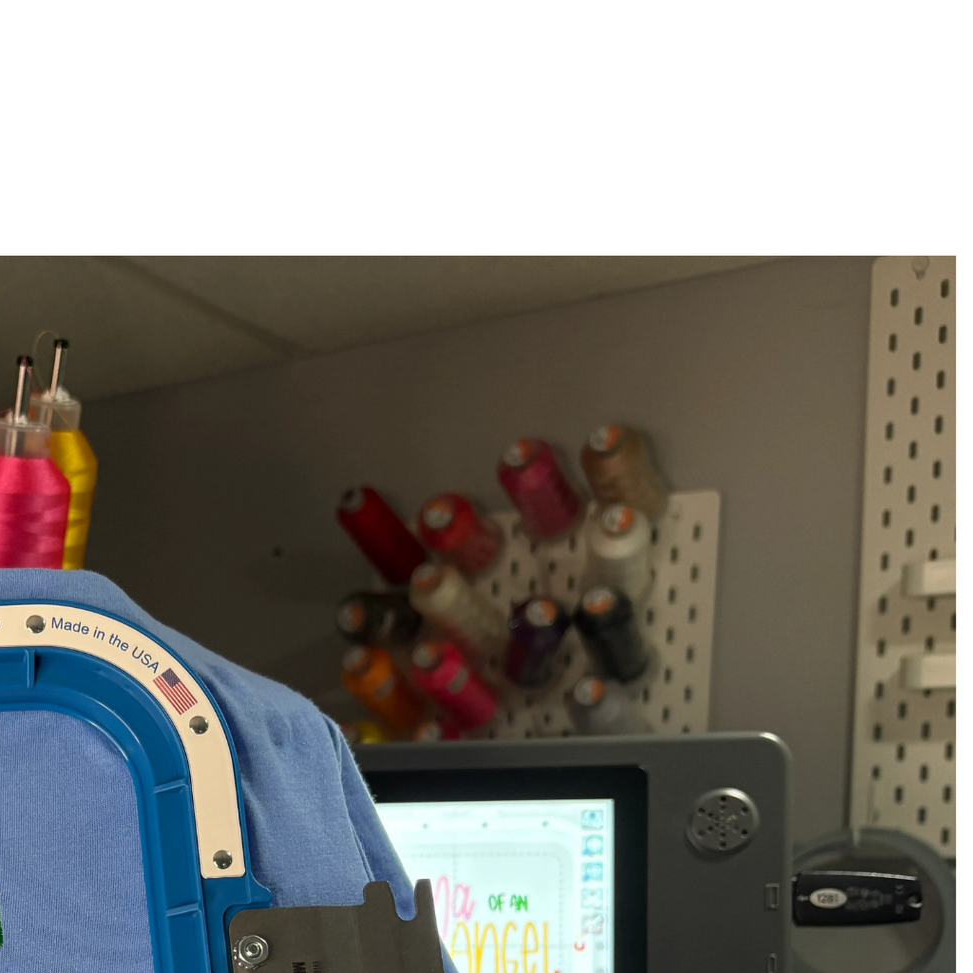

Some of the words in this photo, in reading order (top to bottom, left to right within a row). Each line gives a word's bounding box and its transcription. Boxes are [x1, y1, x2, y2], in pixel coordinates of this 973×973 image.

[51, 617, 90, 635] Made
[93, 626, 106, 641] in
[108, 633, 129, 652] the
[131, 646, 159, 674] USA
[488, 893, 506, 912] OF
